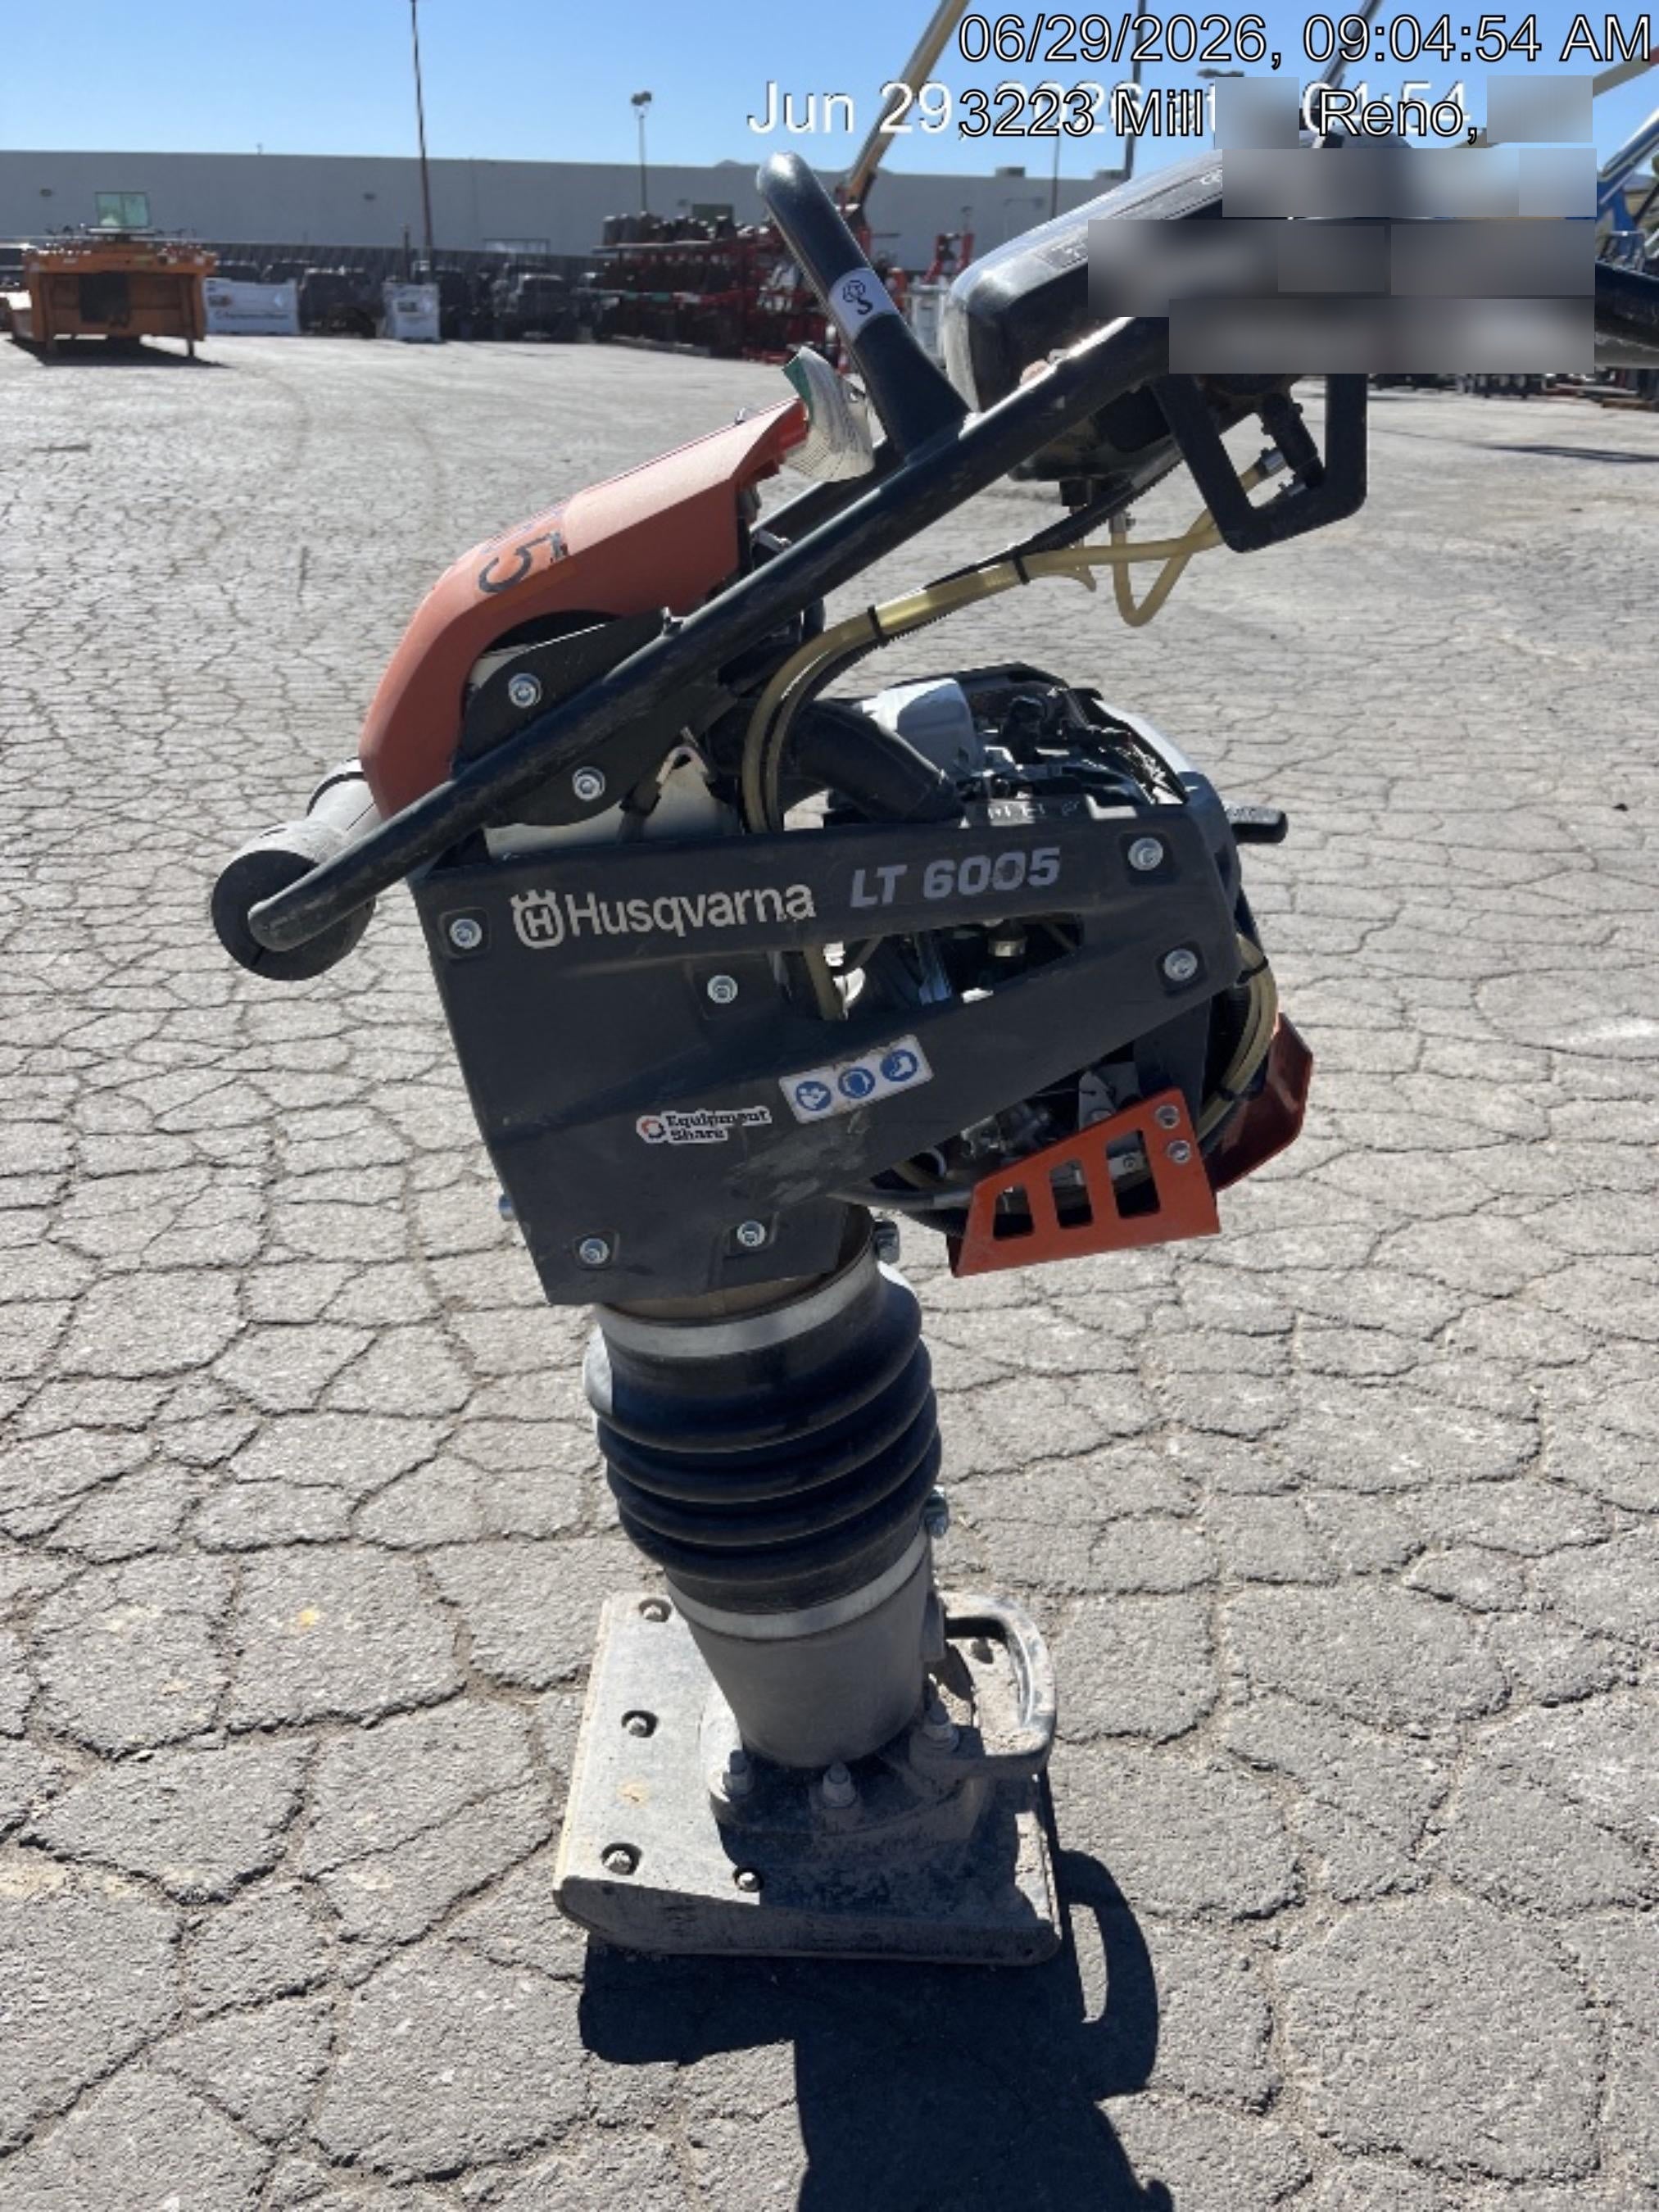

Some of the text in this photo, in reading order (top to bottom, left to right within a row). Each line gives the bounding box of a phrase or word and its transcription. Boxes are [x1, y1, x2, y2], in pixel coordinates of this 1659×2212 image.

[850, 847, 1061, 909] LT 6005
[564, 883, 817, 937] Husqvarna
